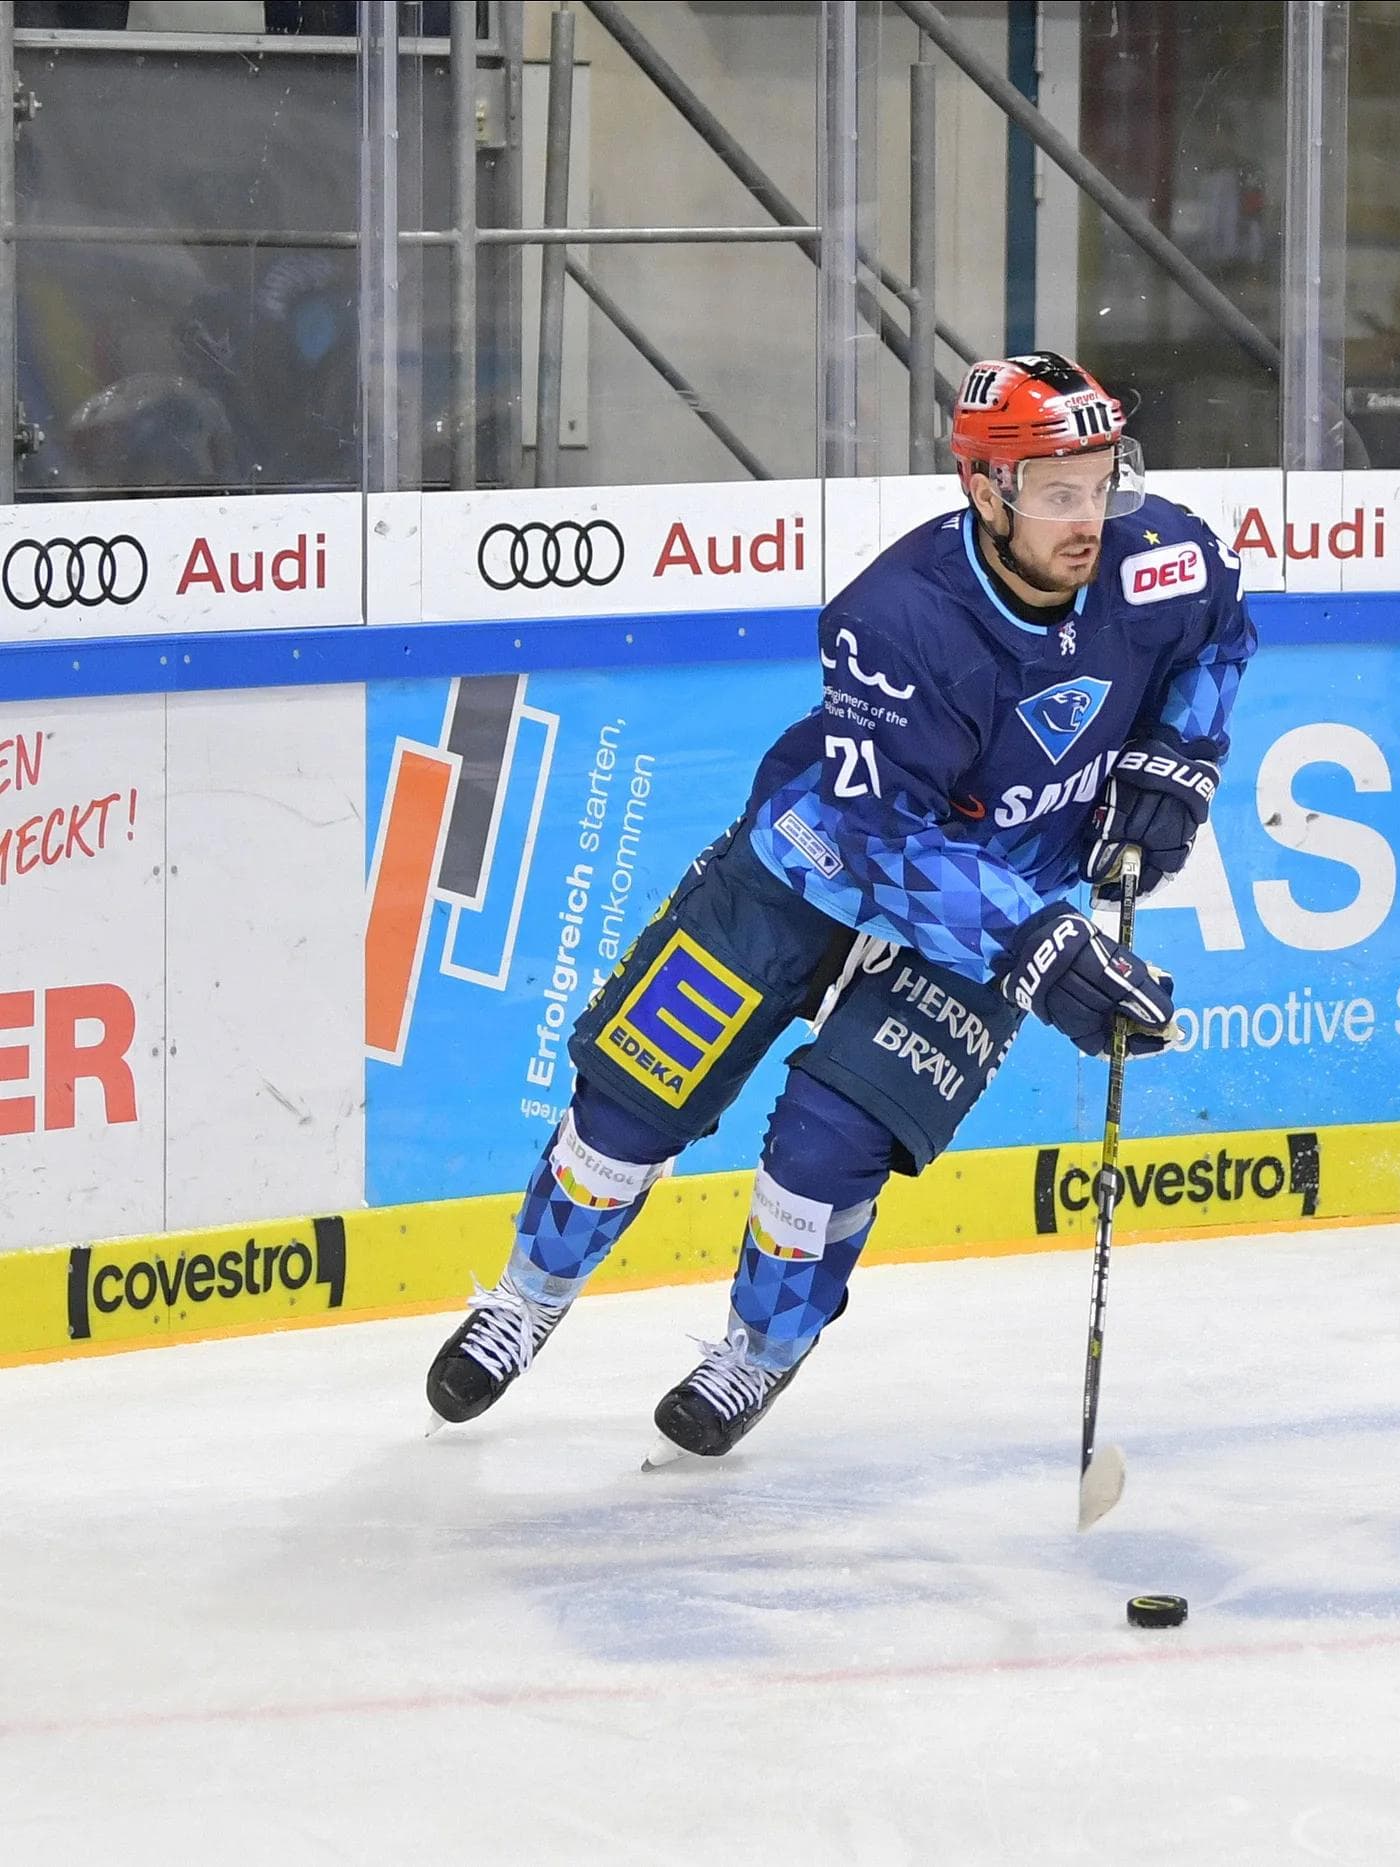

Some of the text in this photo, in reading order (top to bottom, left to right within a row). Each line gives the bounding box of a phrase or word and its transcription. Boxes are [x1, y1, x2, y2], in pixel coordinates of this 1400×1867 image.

[176, 534, 327, 594] Audi
[653, 519, 804, 577] Audi
[1232, 508, 1385, 559] Audi
[1132, 551, 1197, 593] DEL
[870, 707, 885, 719] of
[886, 711, 908, 727] the
[825, 734, 882, 799] 21
[994, 750, 1118, 828] SATU
[599, 755, 656, 958] ankommen
[527, 863, 593, 1090] Erfolgreich
[580, 717, 626, 853] starten,
[1015, 919, 1079, 1011] AUER
[1170, 986, 1375, 1052] omotive
[609, 1026, 684, 1094] EDEKA
[873, 1016, 964, 1101] BRÄU
[1060, 1148, 1286, 1212] covestro
[93, 1238, 313, 1314] covestro
